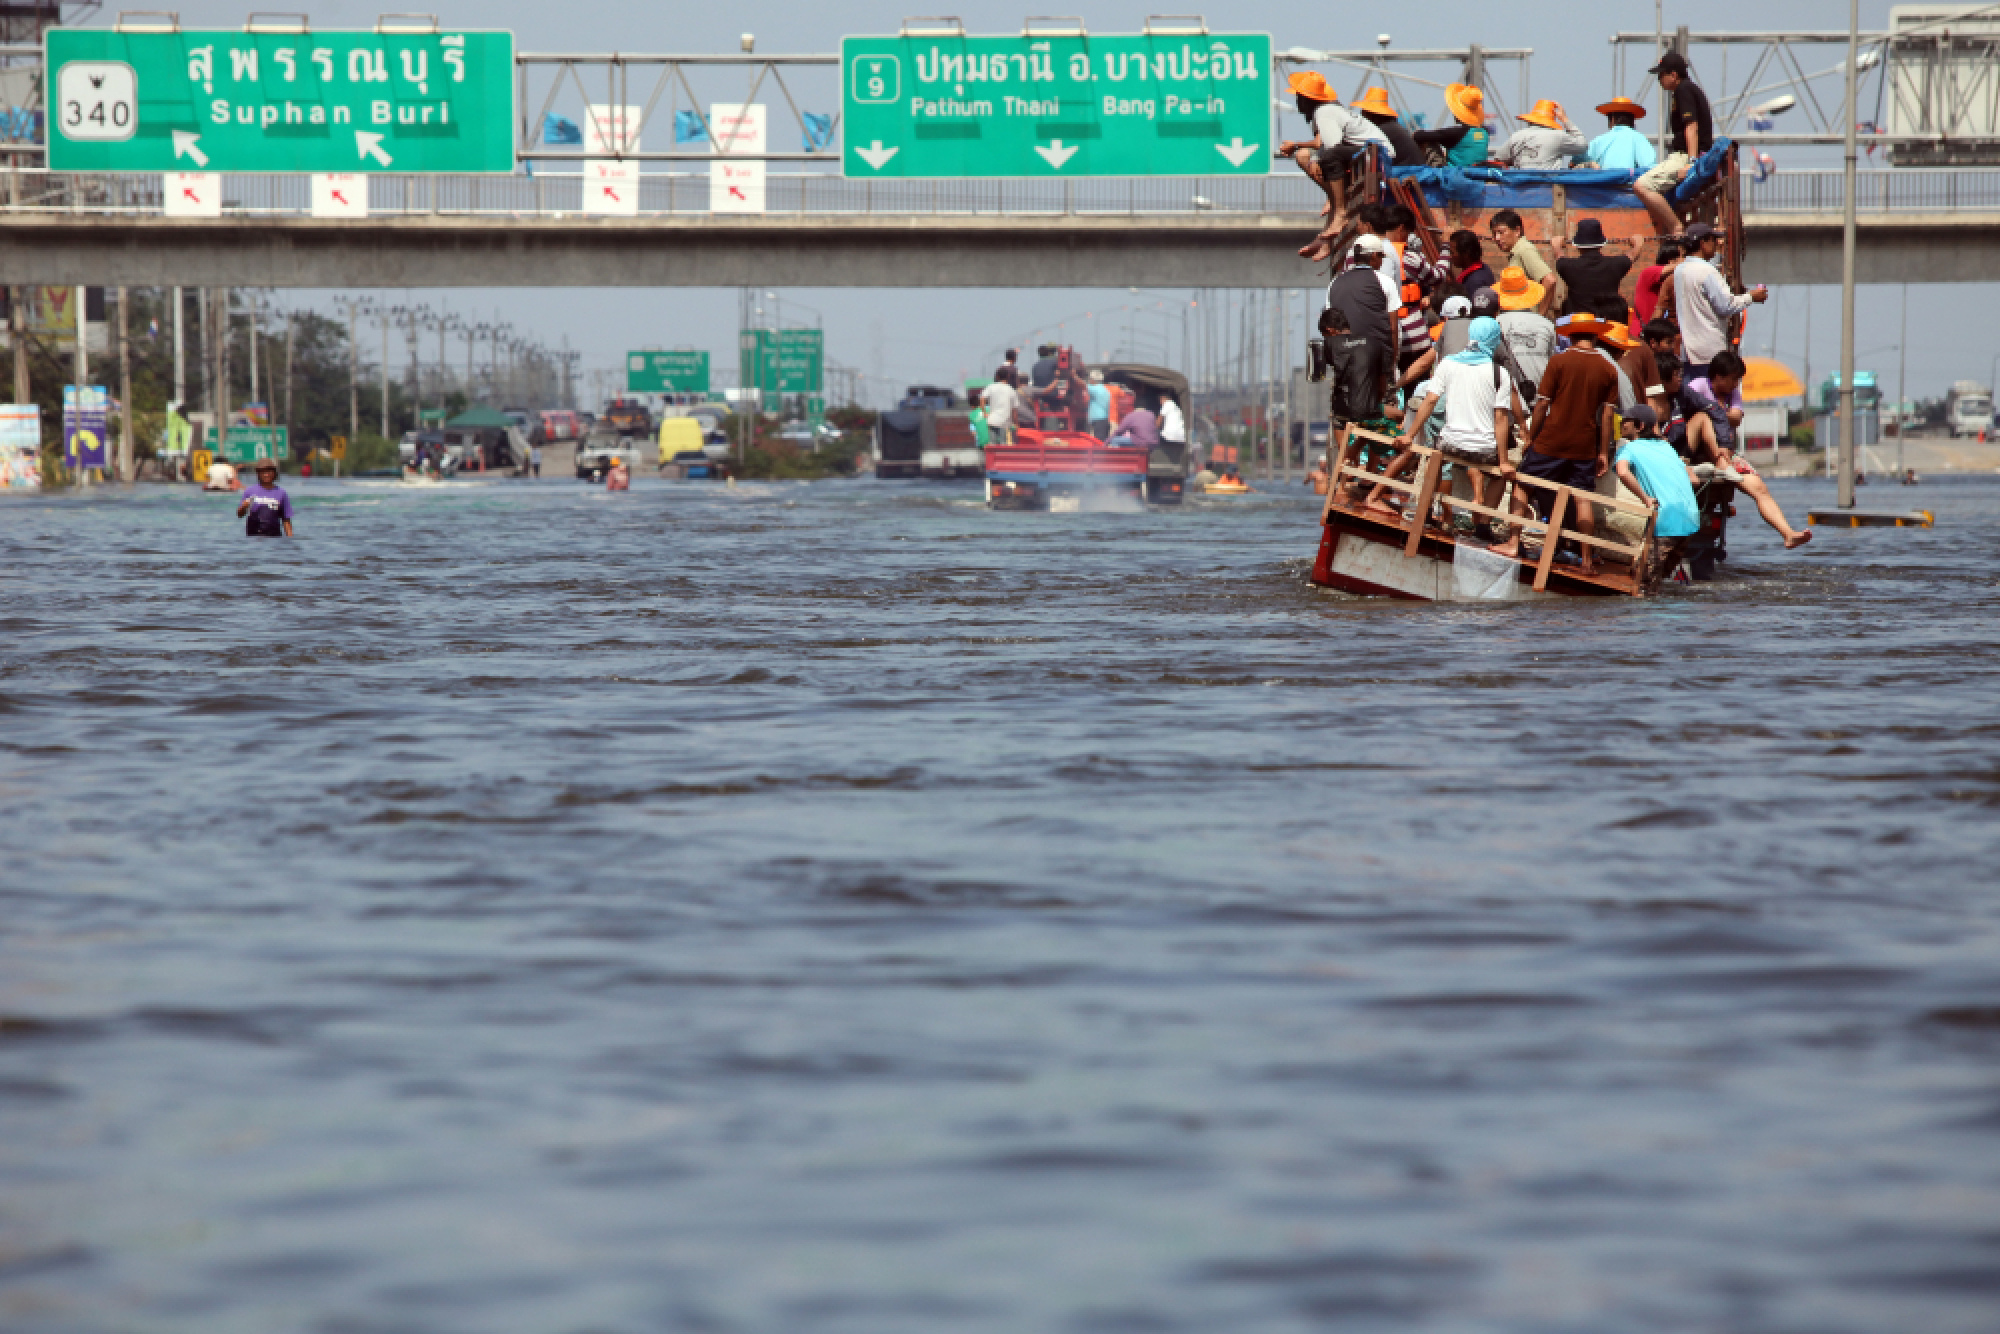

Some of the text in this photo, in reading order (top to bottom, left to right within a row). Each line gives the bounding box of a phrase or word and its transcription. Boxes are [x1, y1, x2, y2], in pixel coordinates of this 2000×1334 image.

[188, 33, 465, 95] สุพรรณบุรี
[915, 42, 1054, 95] ปทุมธานี
[867, 76, 885, 98] 9
[66, 102, 130, 126] 340
[210, 101, 450, 127] Suphan Buri
[911, 96, 1225, 119] Pathum Thani Bang Pa-in
